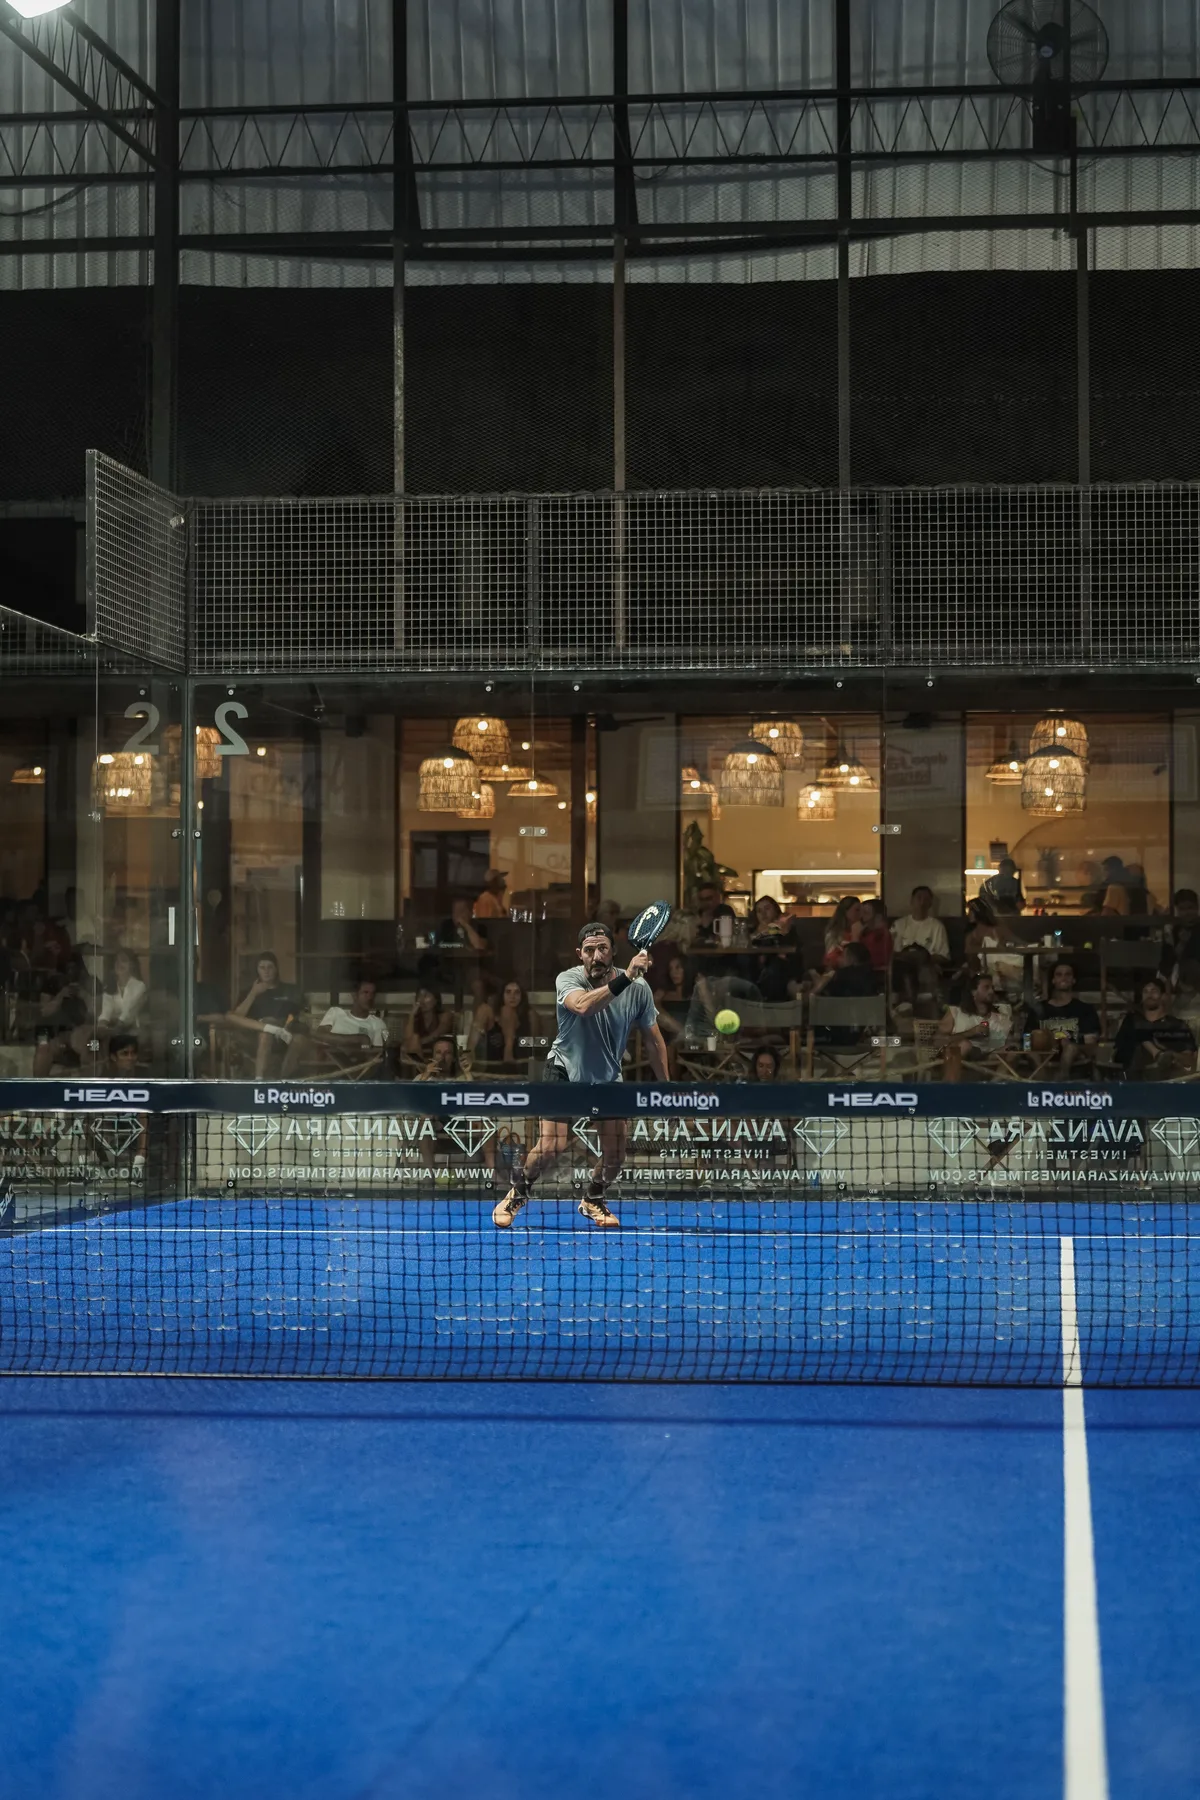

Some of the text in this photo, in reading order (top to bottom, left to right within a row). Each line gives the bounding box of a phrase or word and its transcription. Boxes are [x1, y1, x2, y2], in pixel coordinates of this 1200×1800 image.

[122, 702, 159, 754] 2
[64, 1089, 150, 1102] HEAD
[267, 1088, 335, 1107] Reunion
[441, 1092, 529, 1106] HEAD
[650, 1091, 719, 1110] Reunion
[828, 1093, 918, 1106] HEAD
[1042, 1090, 1113, 1110] Reunion
